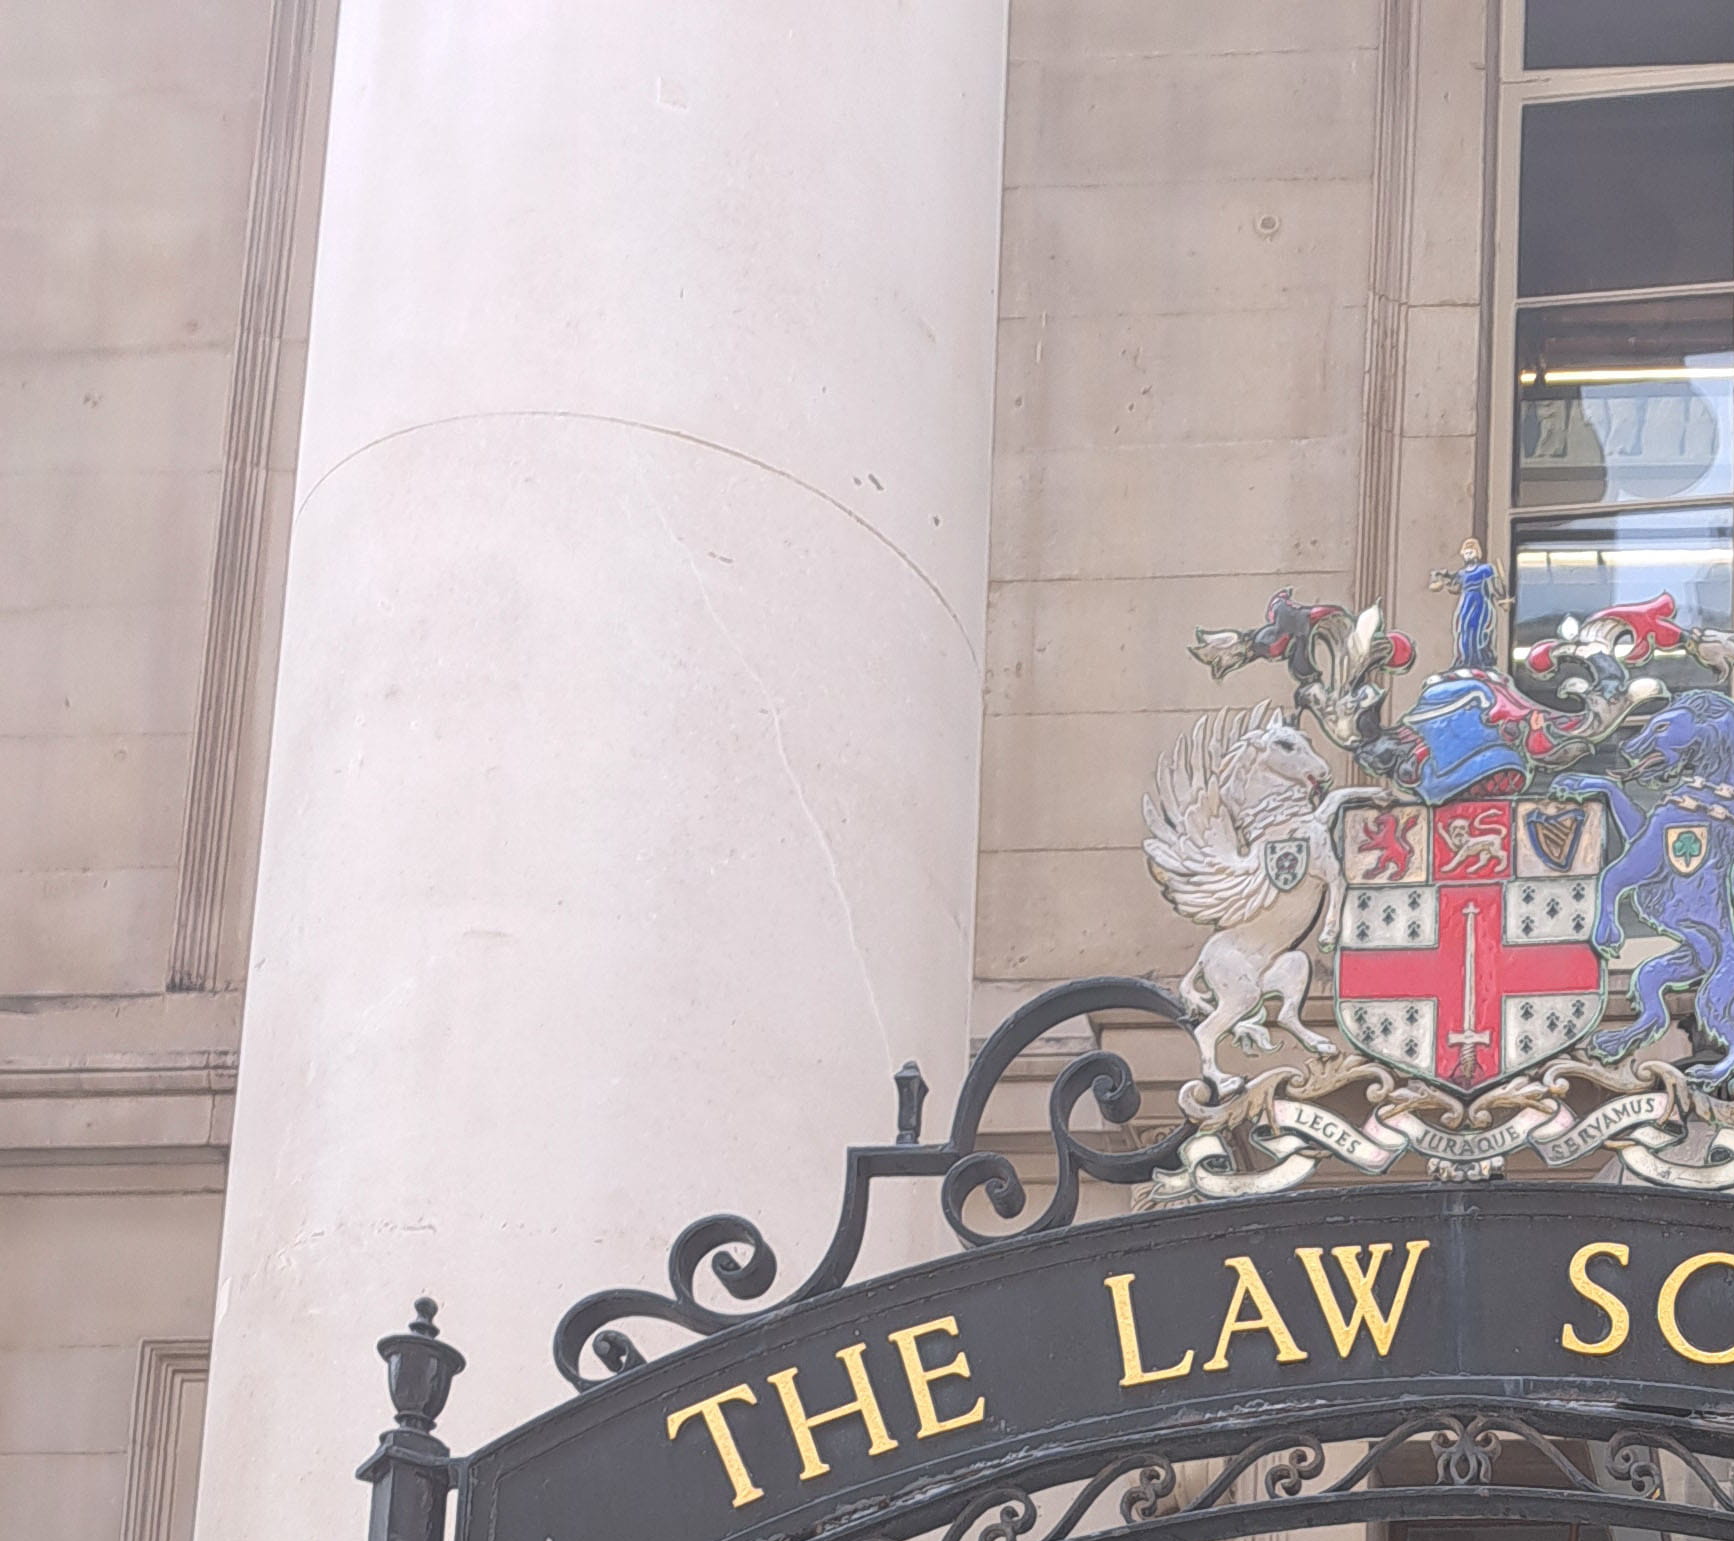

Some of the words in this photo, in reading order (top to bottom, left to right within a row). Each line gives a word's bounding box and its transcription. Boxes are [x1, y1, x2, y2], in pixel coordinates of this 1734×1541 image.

[1295, 1107, 1361, 1154] LEGES
[1416, 1126, 1520, 1156] JURAQUE
[1549, 1098, 1655, 1160] SERVAMUS
[666, 1315, 985, 1509] THE
[1103, 1239, 1430, 1388] LAW
